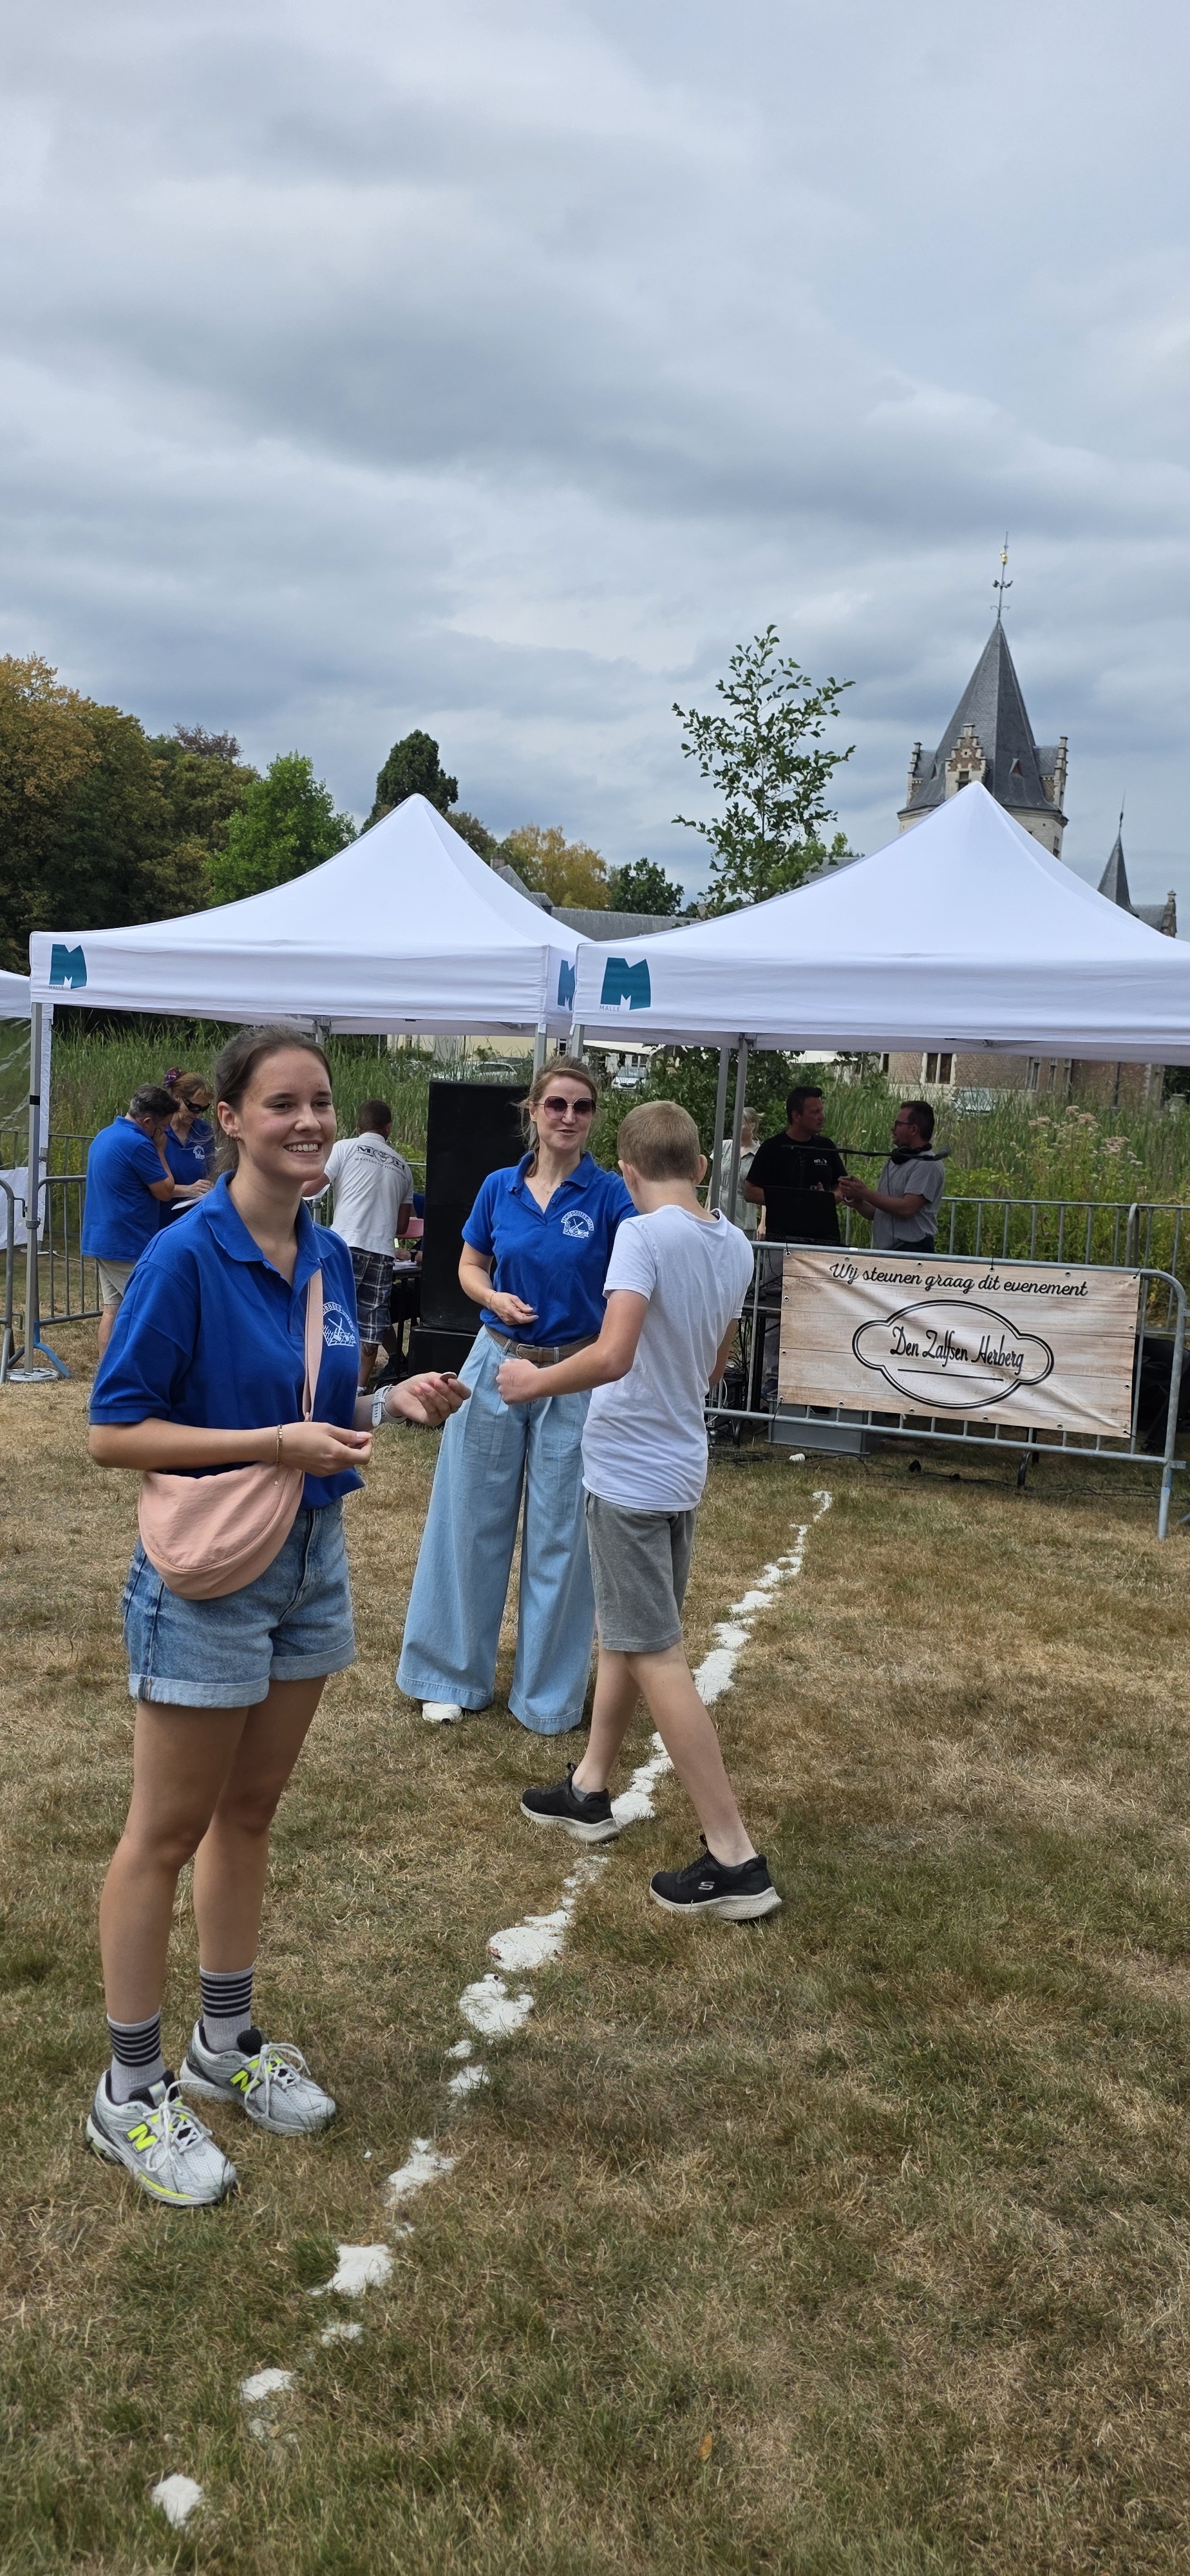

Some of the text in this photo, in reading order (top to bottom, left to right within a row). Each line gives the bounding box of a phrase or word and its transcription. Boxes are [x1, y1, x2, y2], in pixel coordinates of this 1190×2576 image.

[829, 1263, 1088, 1296] Wij steunen graag dit evenement
[890, 1326, 1024, 1376] Den Zalfsen Herberg
[126, 2123, 157, 2152] N
